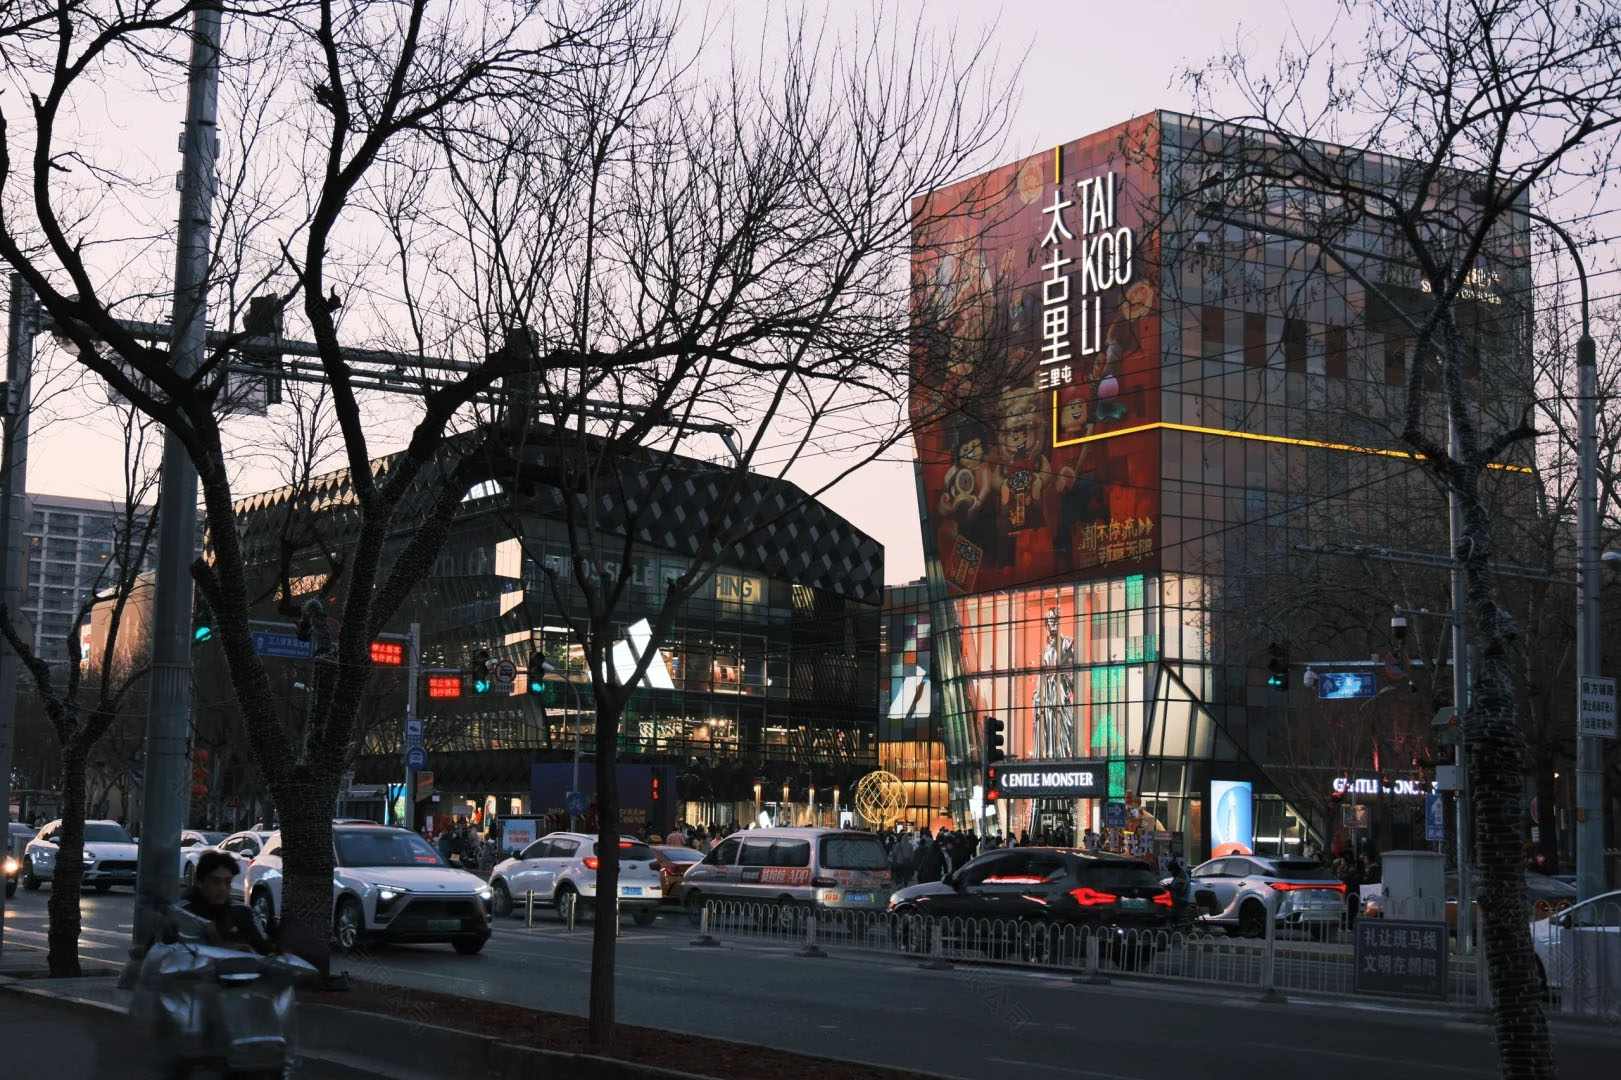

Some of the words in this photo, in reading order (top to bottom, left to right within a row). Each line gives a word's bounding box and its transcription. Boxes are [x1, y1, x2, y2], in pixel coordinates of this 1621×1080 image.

[1077, 171, 1113, 235] TAI
[1040, 189, 1073, 366] 太古里
[1082, 226, 1132, 296] KOO
[1081, 295, 1101, 356] LI
[1038, 364, 1072, 390] 三里屯
[1041, 772, 1093, 786] MONSTER
[1363, 928, 1437, 950] 礼让斑马线
[1363, 954, 1437, 976] 文明在朝阳
